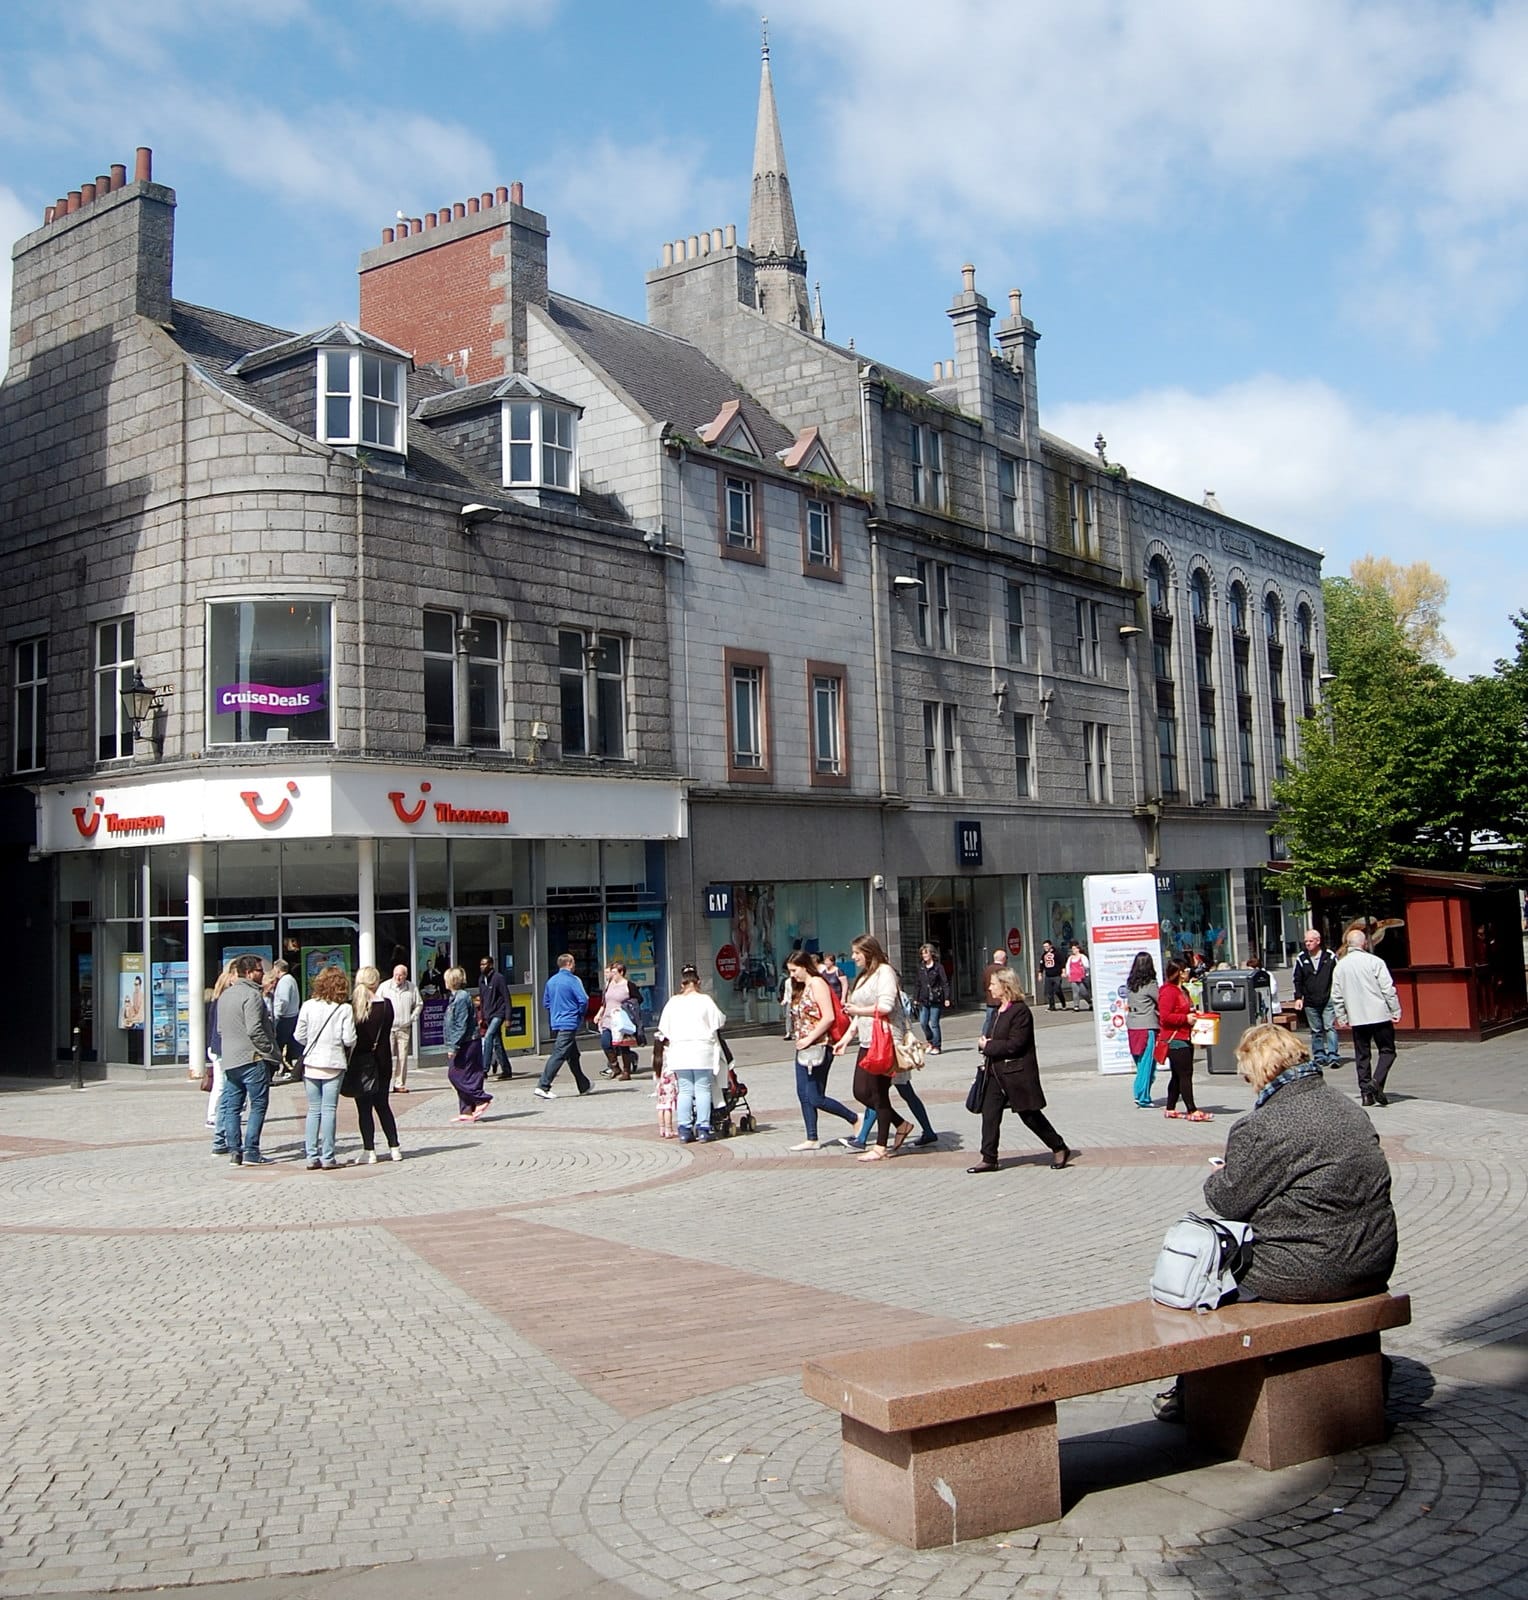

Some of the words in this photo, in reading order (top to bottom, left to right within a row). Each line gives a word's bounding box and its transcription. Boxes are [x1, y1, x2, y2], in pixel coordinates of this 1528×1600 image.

[222, 690, 268, 705] Cruise
[268, 693, 310, 706] Deals
[104, 813, 165, 832] Thomson
[434, 803, 509, 824] Thomson
[709, 893, 728, 912] GAP
[1101, 914, 1135, 922] FESTIVAL
